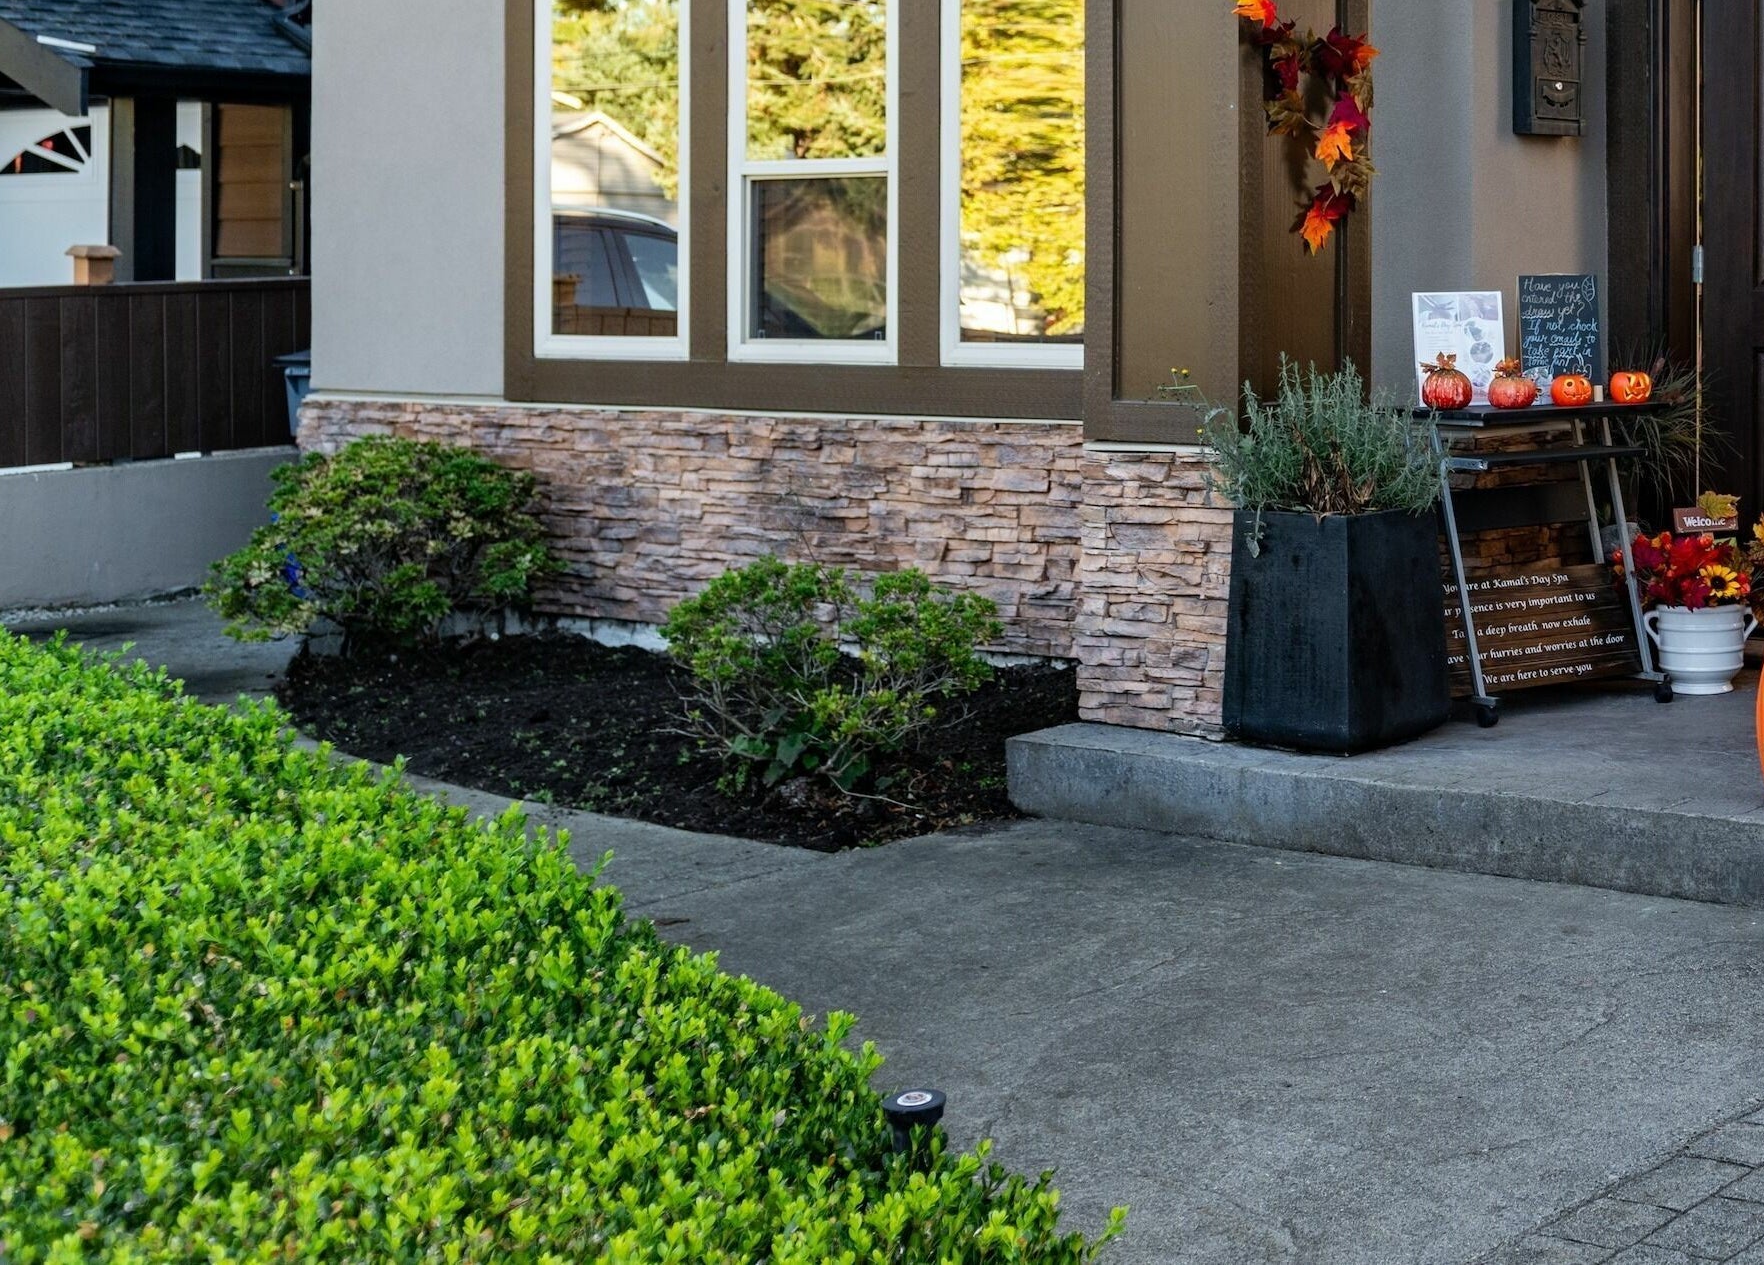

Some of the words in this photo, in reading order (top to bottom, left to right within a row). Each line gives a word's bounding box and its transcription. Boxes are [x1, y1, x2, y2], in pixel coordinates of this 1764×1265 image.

[1523, 277, 1552, 292] Have
[1556, 282, 1580, 298] you
[1521, 291, 1557, 304] entered
[1565, 291, 1582, 303] the
[1522, 304, 1554, 316] draw
[1527, 319, 1541, 335] If
[1522, 334, 1548, 348] your
[1586, 332, 1596, 344] to
[1527, 344, 1549, 357] take
[1582, 343, 1592, 357] in
[1480, 580, 1490, 590] at
[1492, 575, 1529, 588] Kamal's
[1530, 575, 1551, 586] Day
[1552, 573, 1569, 585] Spa
[1454, 603, 1494, 618] psence
[1495, 601, 1503, 610] is
[1504, 600, 1527, 611] very
[1528, 594, 1573, 609] important
[1575, 592, 1584, 601] to
[1585, 592, 1596, 600] us
[1476, 628, 1483, 636] a
[1485, 624, 1506, 637] deep
[1508, 620, 1539, 634] breath
[1541, 621, 1560, 629] now
[1562, 615, 1591, 627] exhale
[1489, 647, 1523, 659] hurries
[1524, 642, 1543, 654] and
[1543, 640, 1577, 651] worries
[1578, 638, 1588, 648] at
[1590, 635, 1604, 646] the
[1605, 634, 1625, 644] door
[1481, 674, 1498, 684] We
[1500, 673, 1515, 682] are
[1517, 669, 1538, 680] here
[1540, 668, 1549, 678] to
[1550, 665, 1574, 676] serve
[1575, 663, 1593, 675] you
